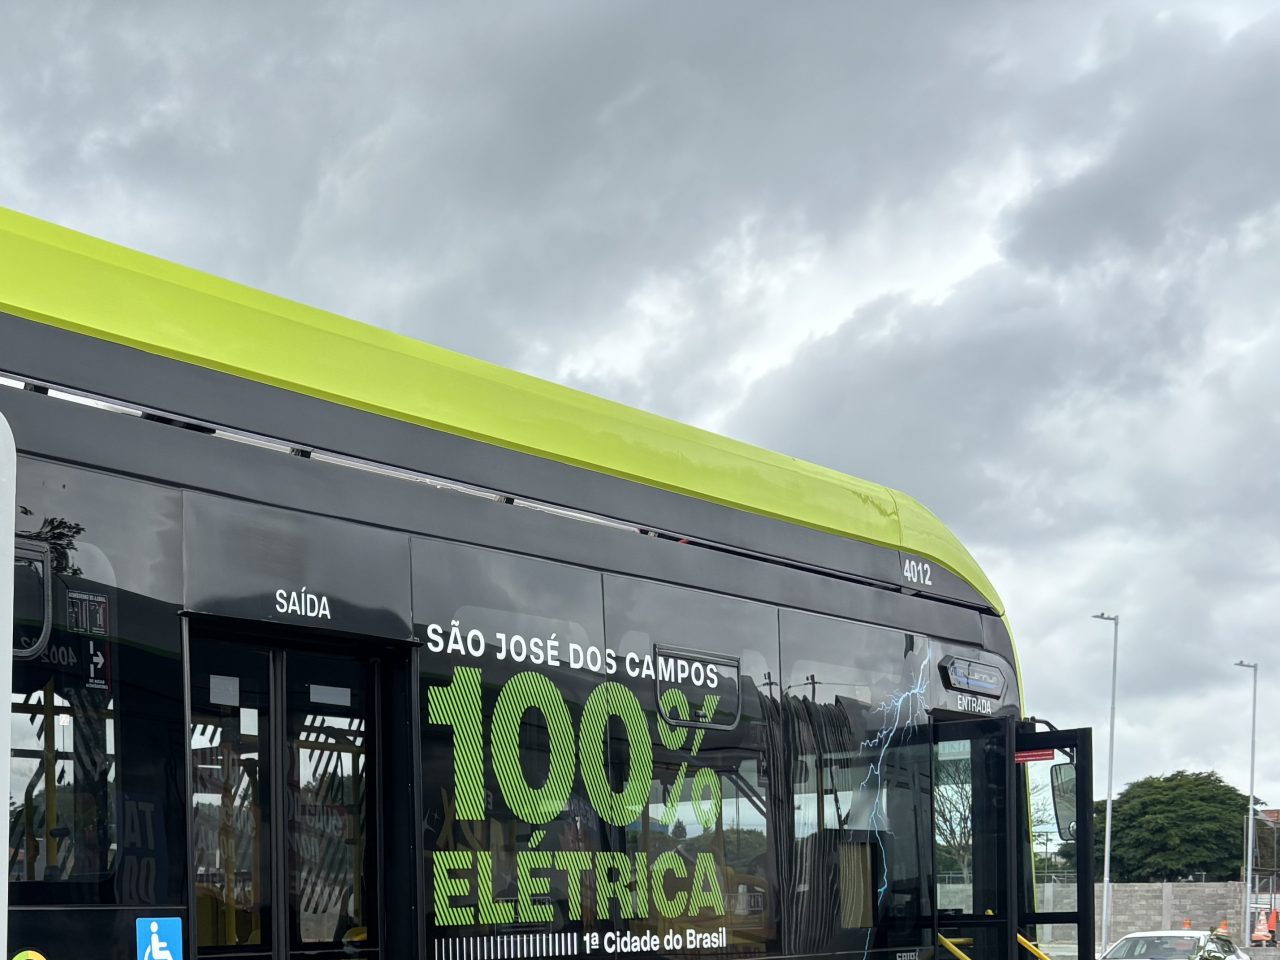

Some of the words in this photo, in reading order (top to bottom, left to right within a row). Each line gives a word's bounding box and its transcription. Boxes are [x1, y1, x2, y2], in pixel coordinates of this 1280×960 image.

[904, 559, 932, 586] 4012
[275, 586, 332, 620] SAÍDA
[426, 620, 485, 658] SÃO
[496, 632, 560, 668] JOSÉ
[570, 643, 617, 675] DOS
[625, 651, 719, 689] CAMPOS
[957, 695, 991, 715] ENTRADA
[428, 667, 722, 830] 100%
[433, 830, 726, 928] ELÉTRICA
[583, 935, 599, 954] 1ª
[604, 931, 660, 954] Cidade
[663, 930, 682, 950] do
[686, 927, 727, 950] Brasil
